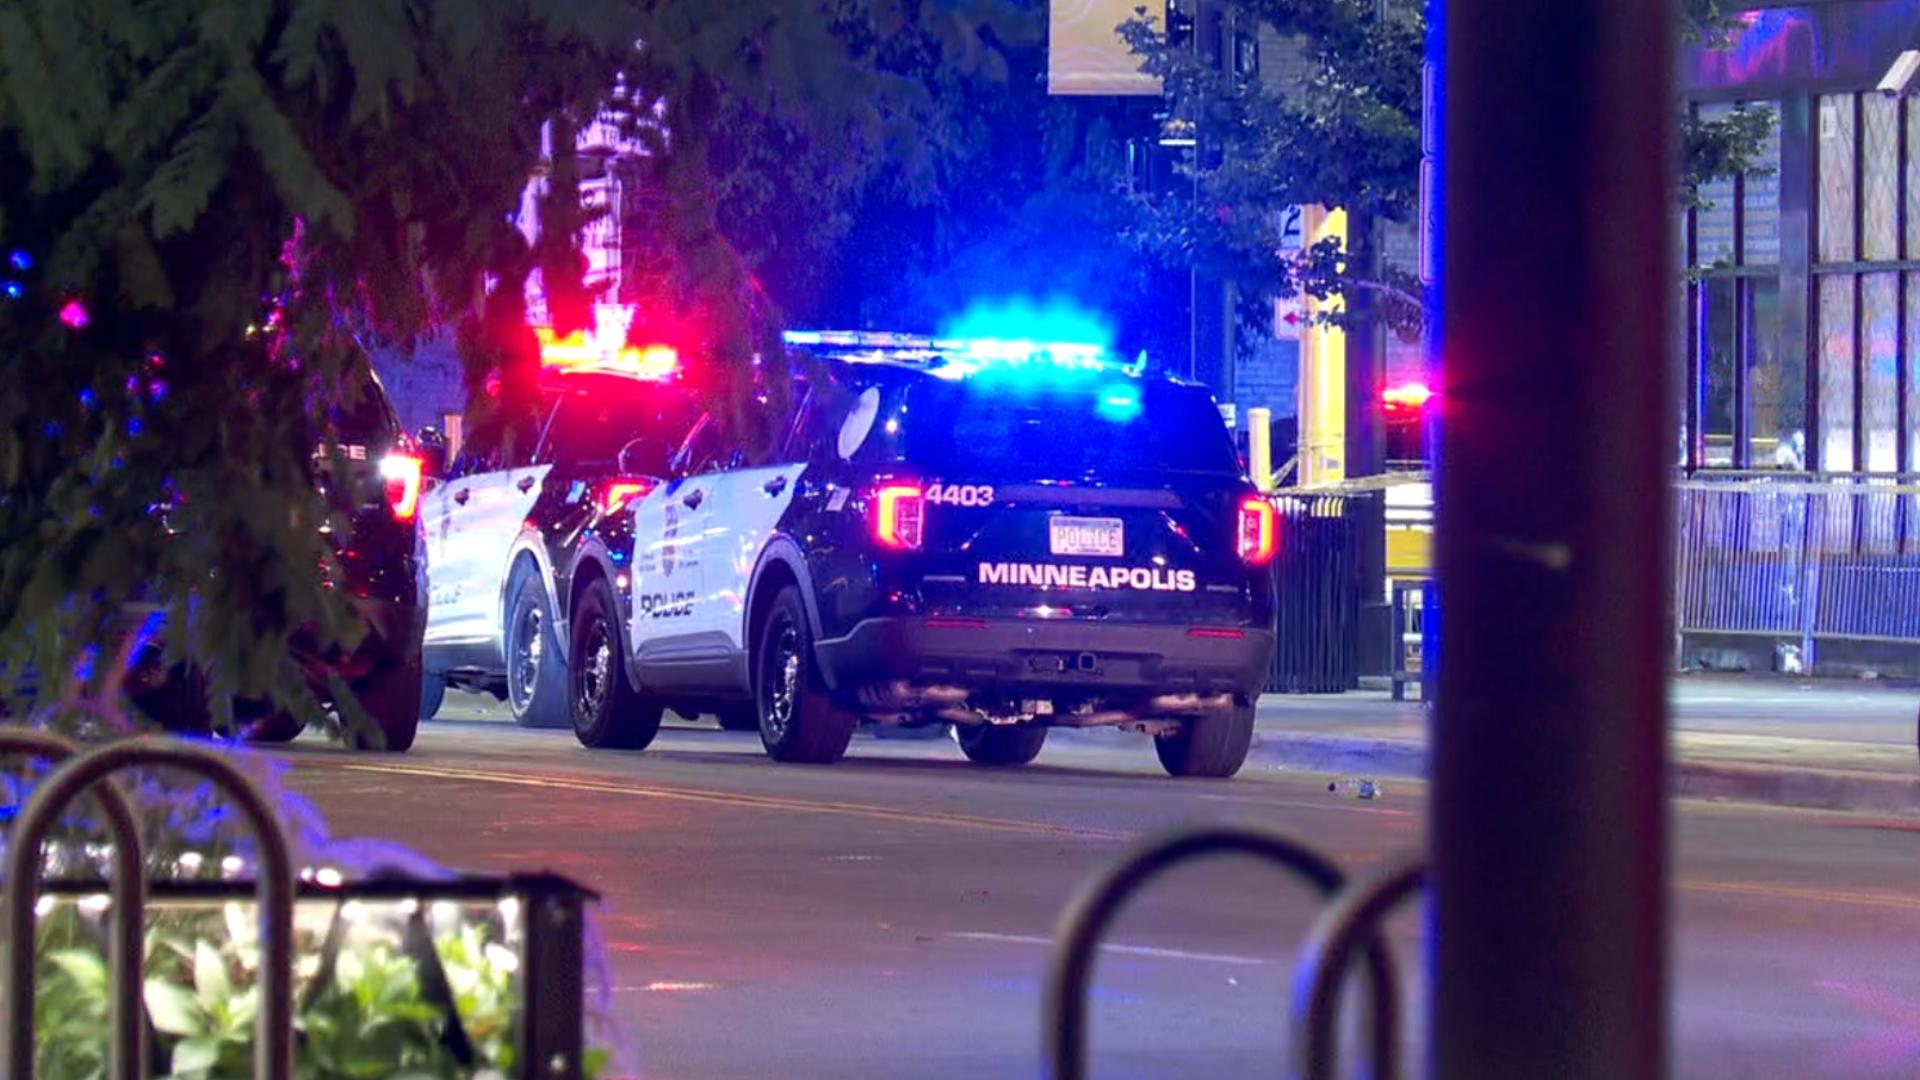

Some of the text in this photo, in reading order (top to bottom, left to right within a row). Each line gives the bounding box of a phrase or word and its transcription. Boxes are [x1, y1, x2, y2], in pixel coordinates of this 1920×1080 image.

[925, 483, 994, 507] 4403
[1056, 527, 1117, 548] POLICE
[979, 562, 1196, 591] MINNEAPOLIS
